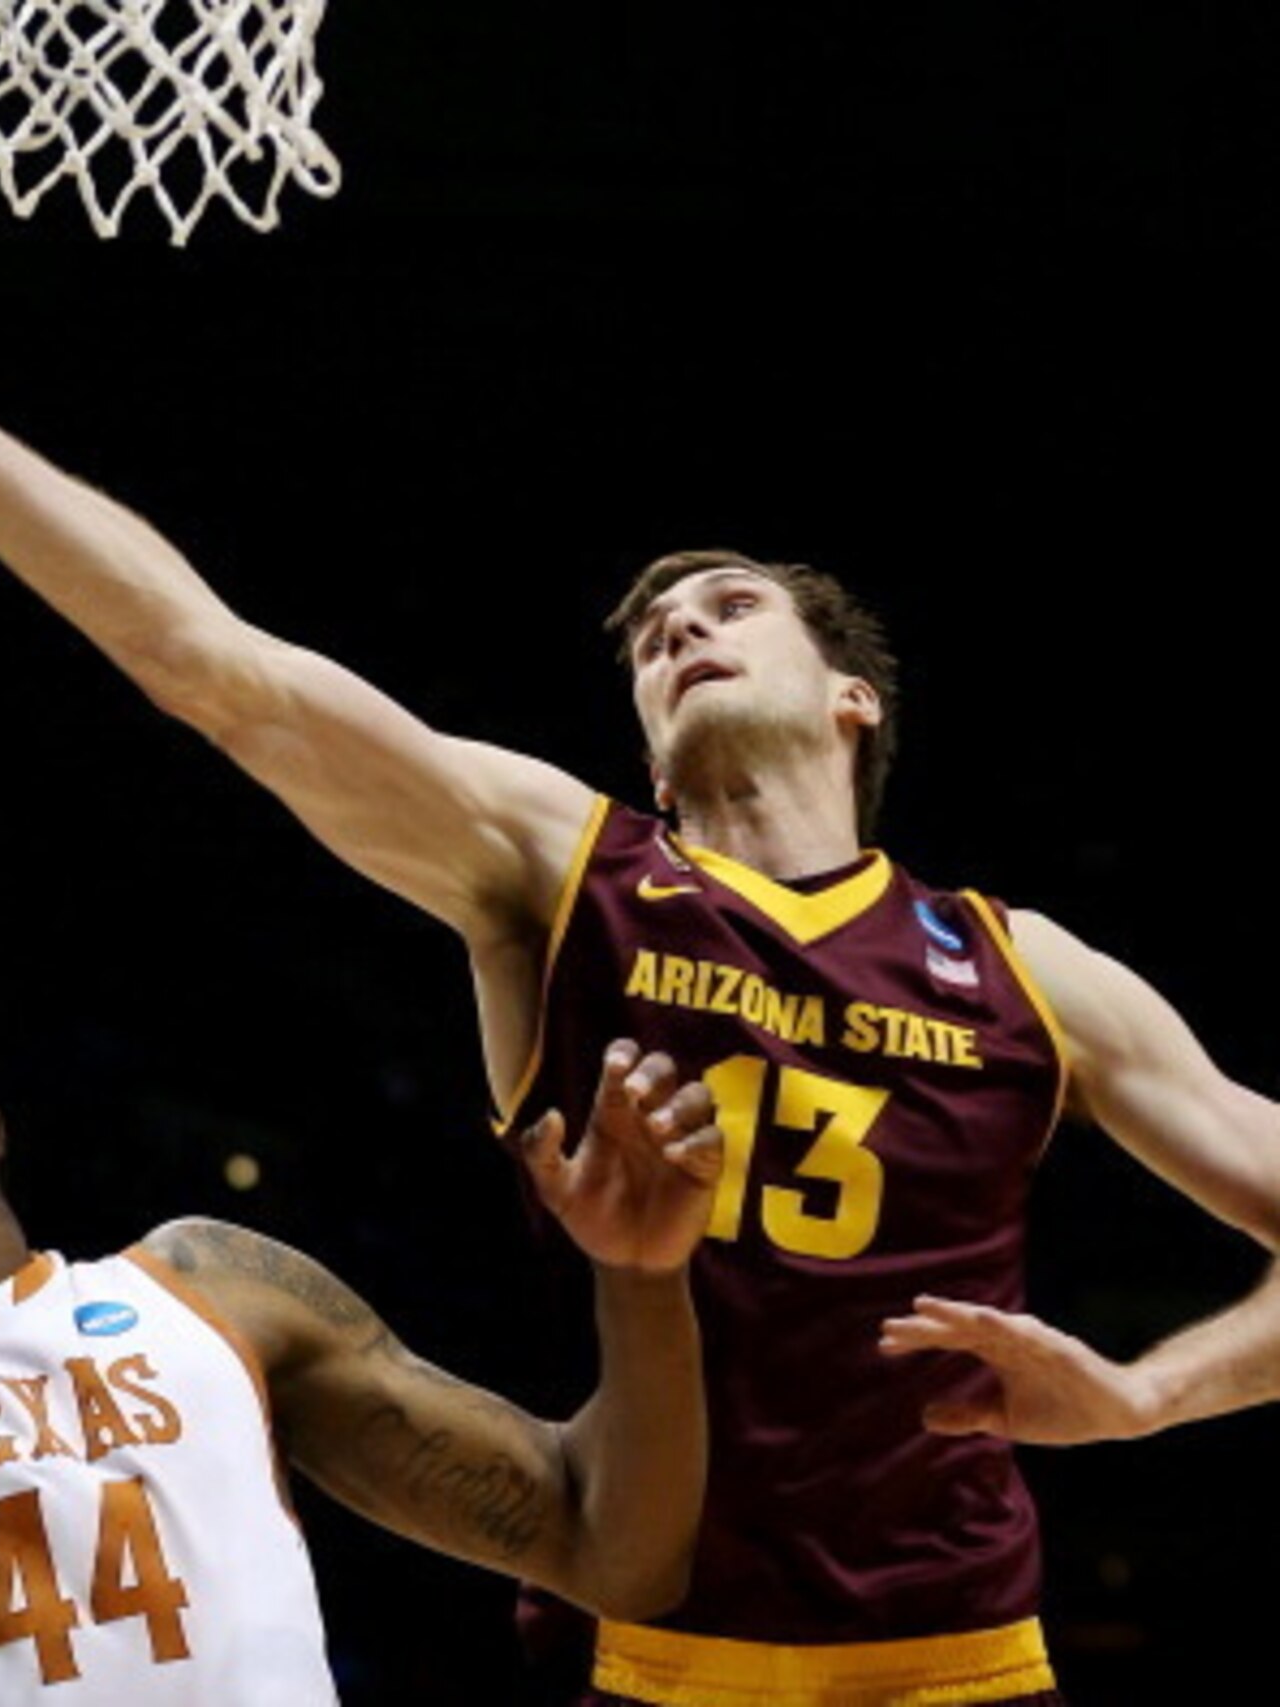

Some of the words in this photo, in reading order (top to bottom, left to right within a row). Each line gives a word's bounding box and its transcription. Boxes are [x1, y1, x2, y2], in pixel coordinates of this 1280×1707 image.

[627, 949, 824, 1046] ARIZONA
[842, 1002, 983, 1069] STATE
[702, 1054, 891, 1259] 13
